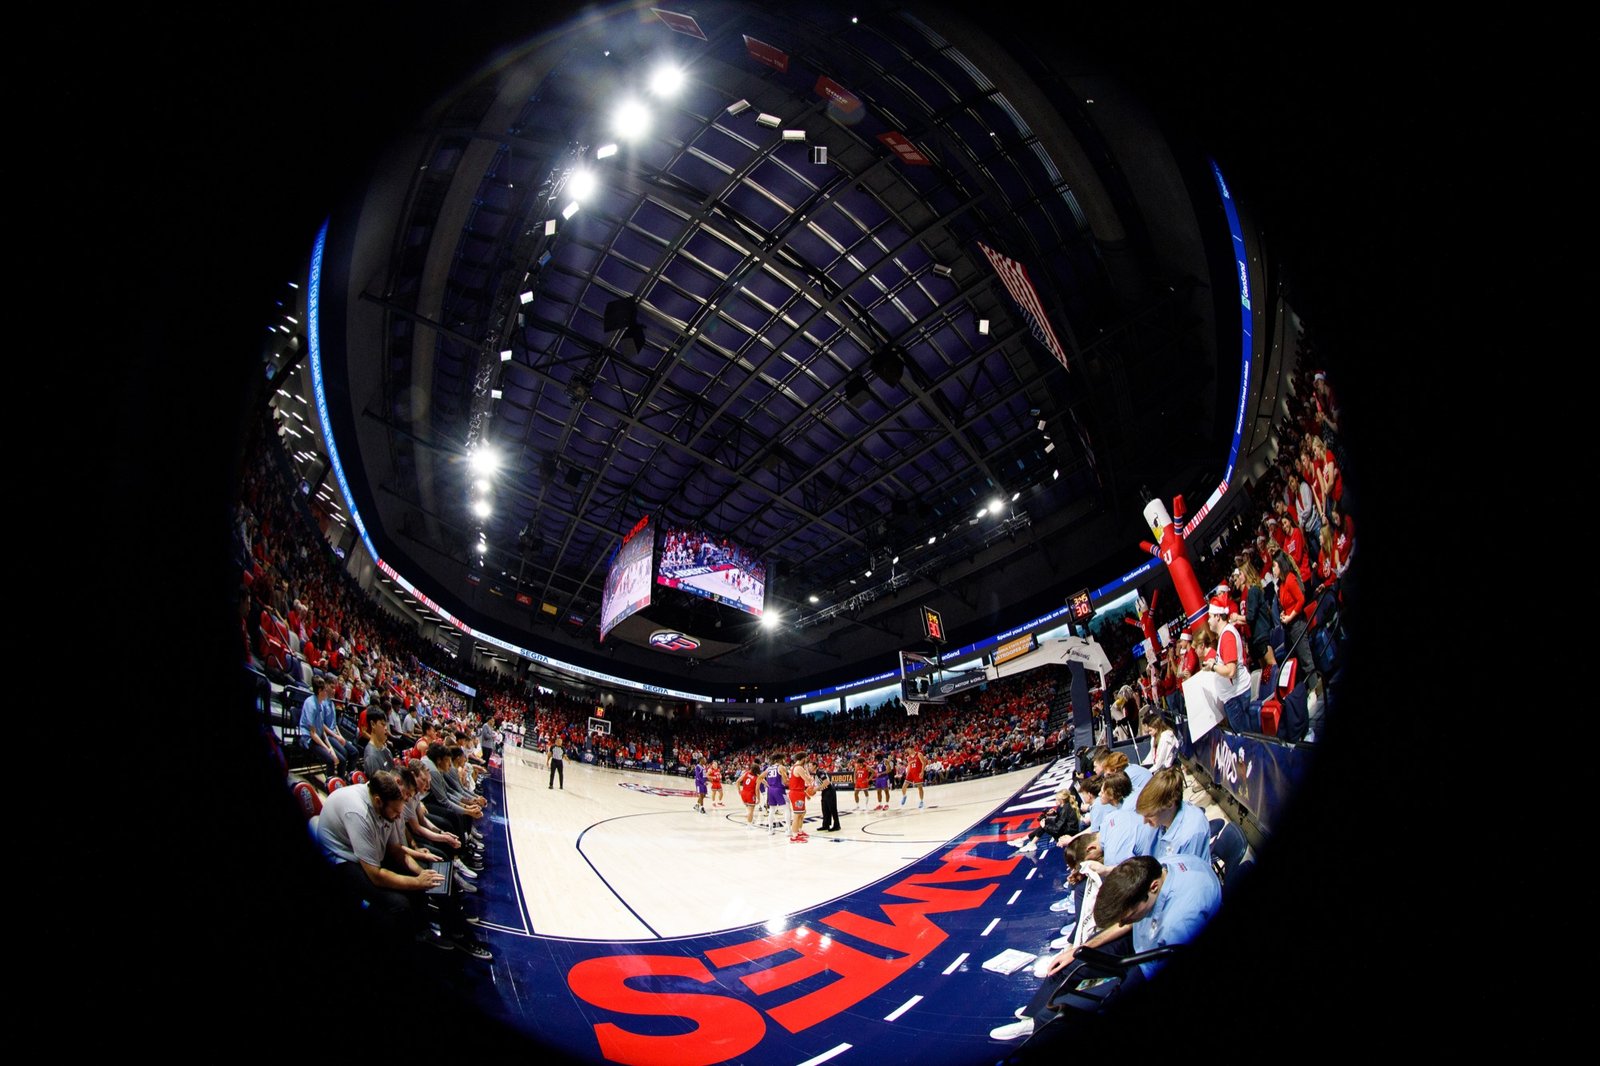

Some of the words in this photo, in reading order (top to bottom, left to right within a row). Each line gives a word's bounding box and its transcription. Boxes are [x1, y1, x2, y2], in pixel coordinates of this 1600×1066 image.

[1238, 260, 1249, 297] GenSend
[1122, 564, 1150, 582] GenSend.org
[1076, 604, 1089, 616] 30
[930, 622, 940, 638] 30
[997, 631, 1012, 640] Spend
[1012, 626, 1023, 635] your
[1023, 619, 1039, 630] school
[1039, 614, 1052, 623] break
[520, 648, 548, 664] SEGRA
[970, 675, 986, 684] WORLD
[643, 684, 669, 695] SEGRA
[568, 811, 1047, 1066] FLAMES
